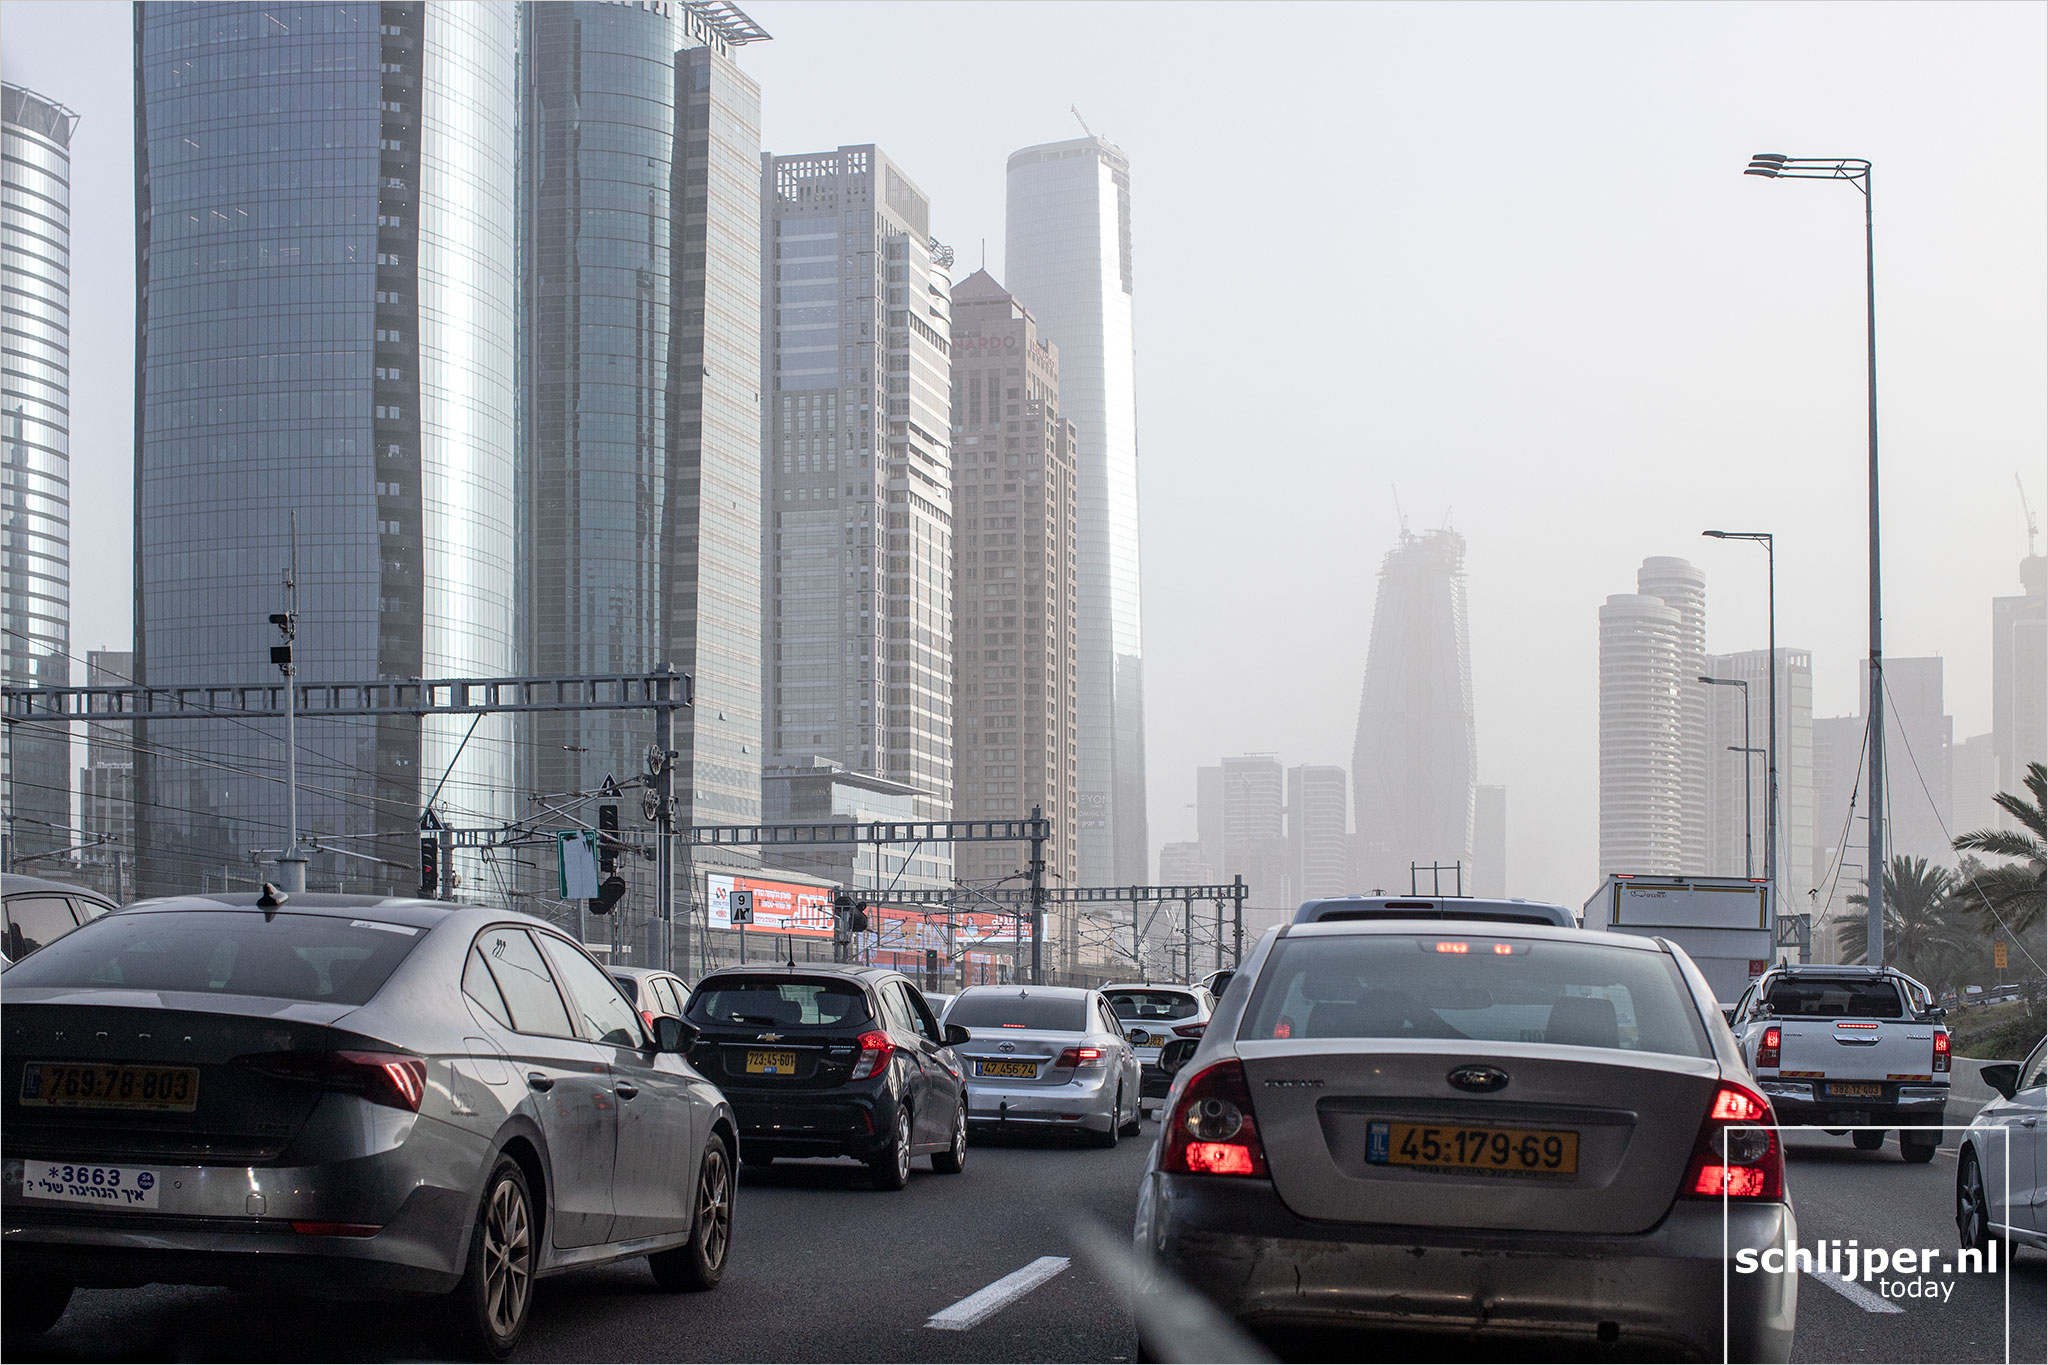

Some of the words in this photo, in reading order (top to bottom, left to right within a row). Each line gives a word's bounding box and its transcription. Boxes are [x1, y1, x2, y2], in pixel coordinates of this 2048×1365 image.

[738, 895, 745, 905] 9
[39, 1178, 64, 1194] שלי
[69, 1184, 118, 1199] הנהיגה
[121, 1188, 145, 1204] איך
